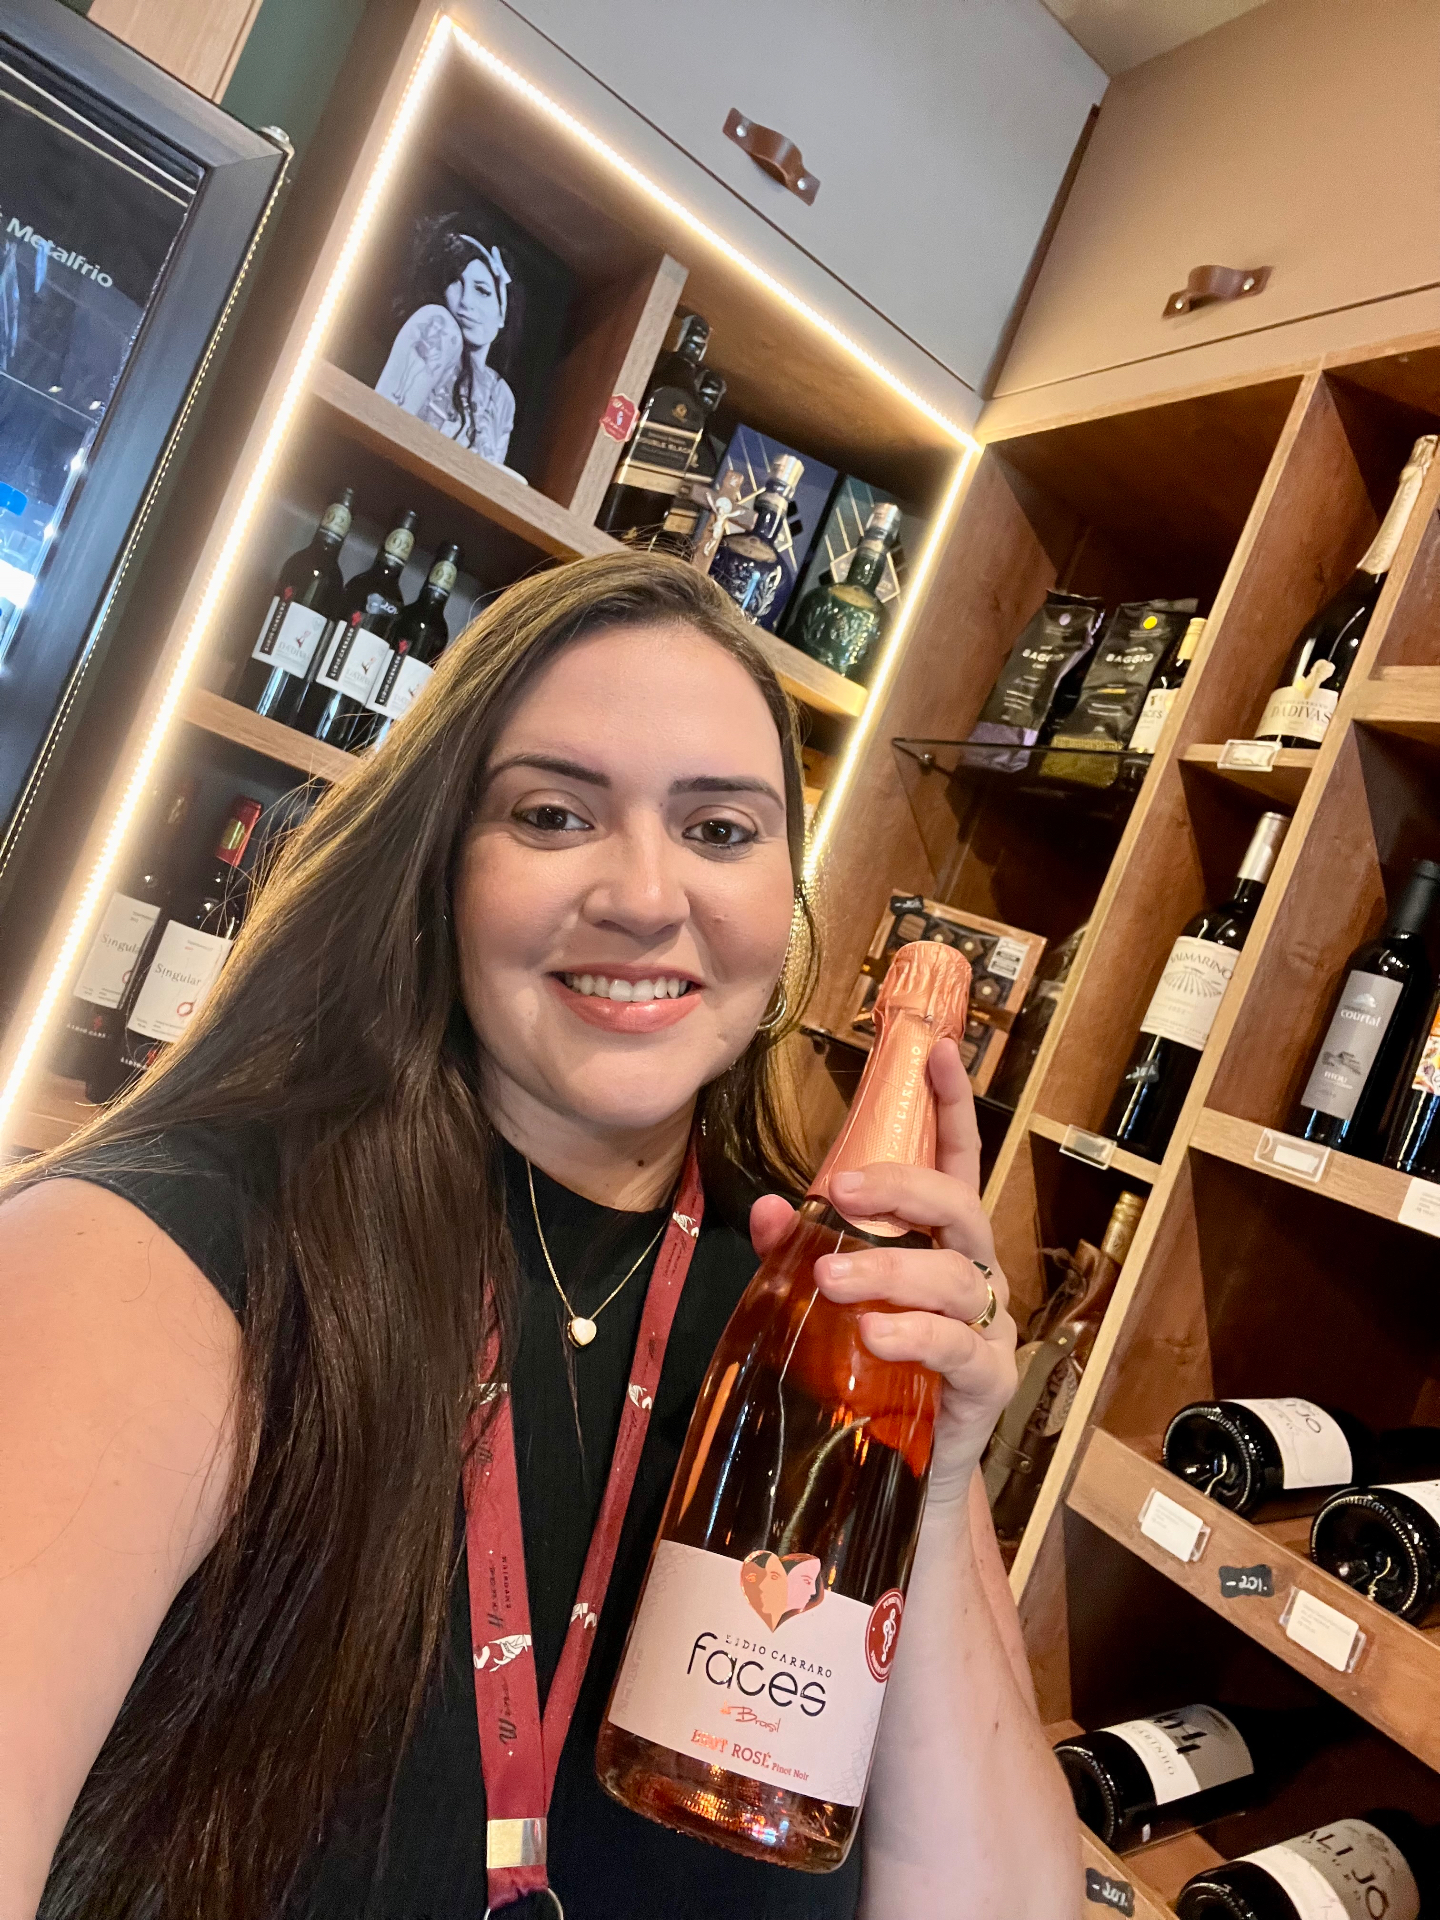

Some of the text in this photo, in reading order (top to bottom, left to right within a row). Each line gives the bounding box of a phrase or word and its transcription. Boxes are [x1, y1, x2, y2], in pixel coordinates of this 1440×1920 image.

[6, 217, 113, 288] Metalfrio
[101, 934, 142, 955] Singula
[155, 963, 202, 986] Singular
[687, 1631, 826, 1717] faces
[725, 1634, 832, 1678] LIDIO CARRARO
[728, 1706, 782, 1733] Brasil
[731, 1743, 772, 1769] ROSÉ
[771, 1762, 792, 1776] Pinot
[794, 1768, 810, 1781] Noir
